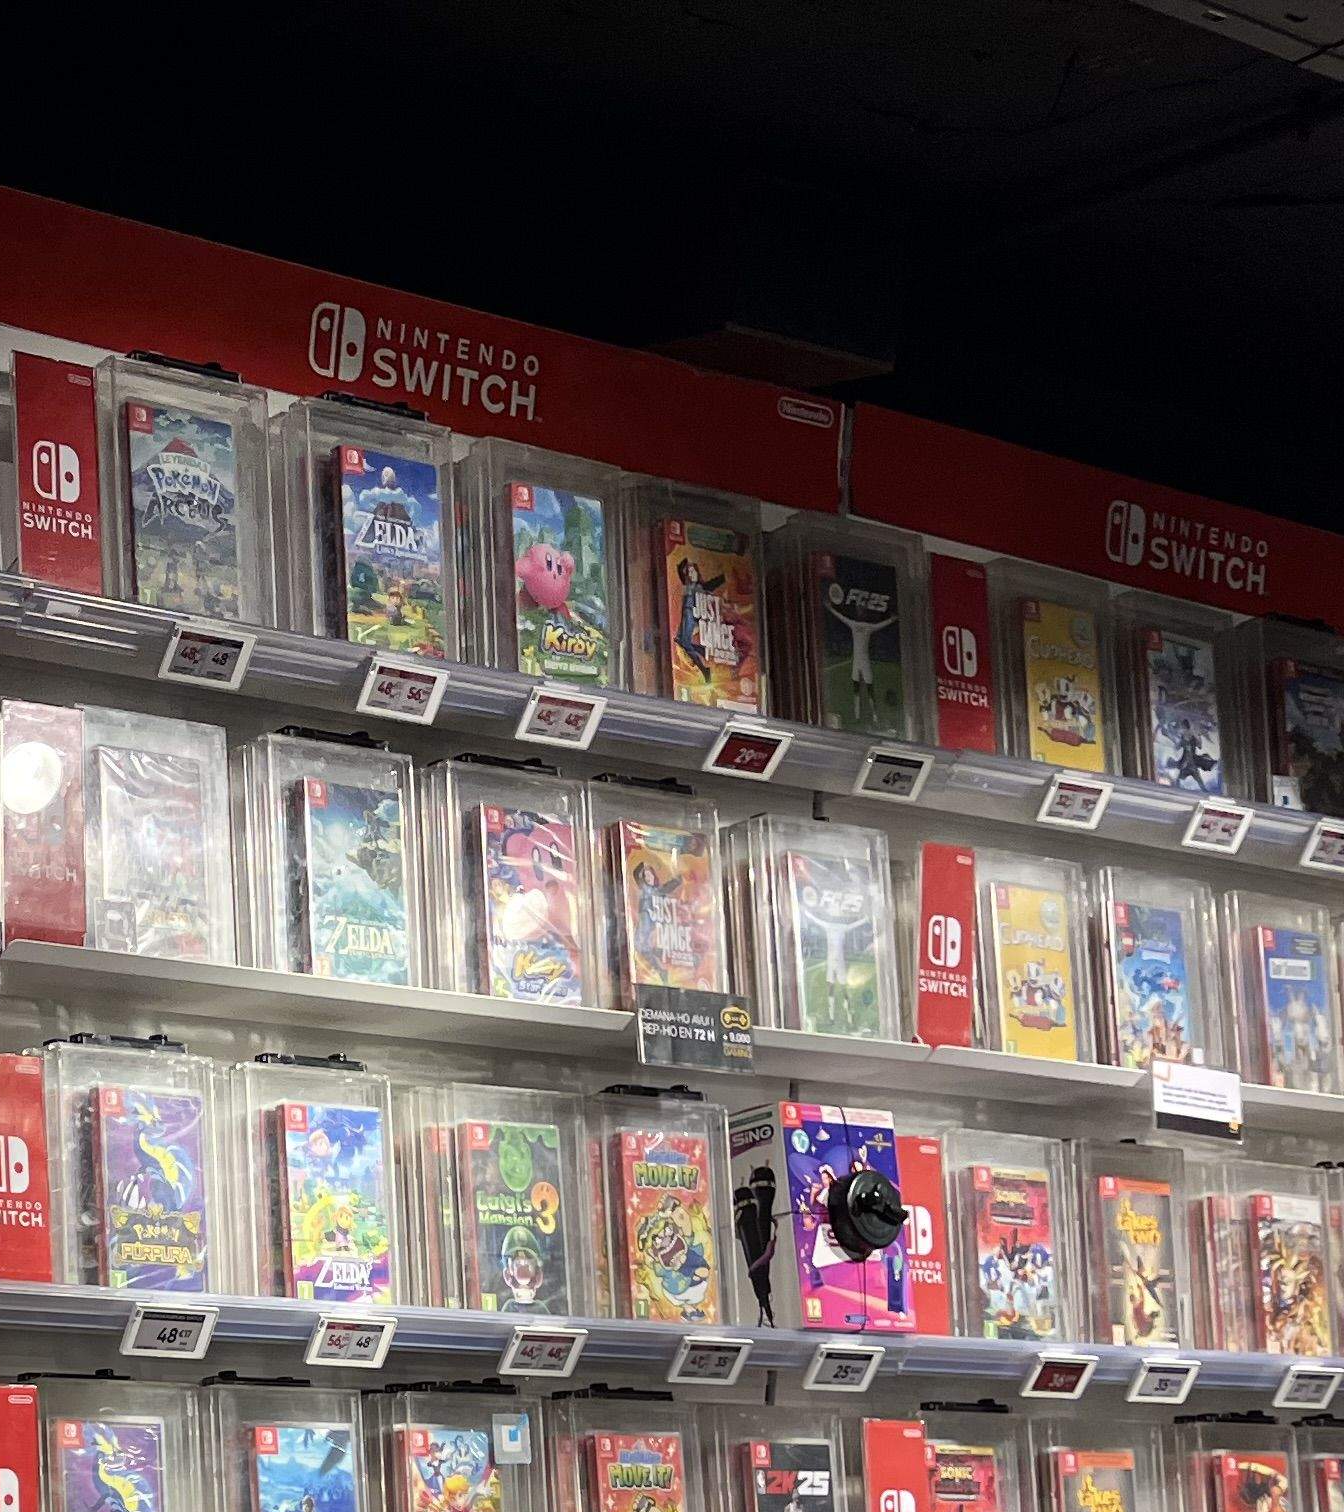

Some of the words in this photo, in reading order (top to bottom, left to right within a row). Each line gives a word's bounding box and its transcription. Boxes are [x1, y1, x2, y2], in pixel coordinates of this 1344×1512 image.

[377, 318, 540, 374] NINTENDO
[372, 349, 537, 421] SWITCH
[23, 501, 92, 523] NINTENDO
[23, 513, 93, 540] SWITCH
[354, 512, 418, 551] ZELDA
[1154, 512, 1268, 557] NINTENDO
[1150, 538, 1266, 594] SWITCH
[545, 623, 598, 658] Kirby
[938, 686, 988, 706] SWITCH
[323, 914, 396, 956] ZELDA
[919, 978, 967, 998] SWITCH
[610, 1464, 649, 1490] MOVE
